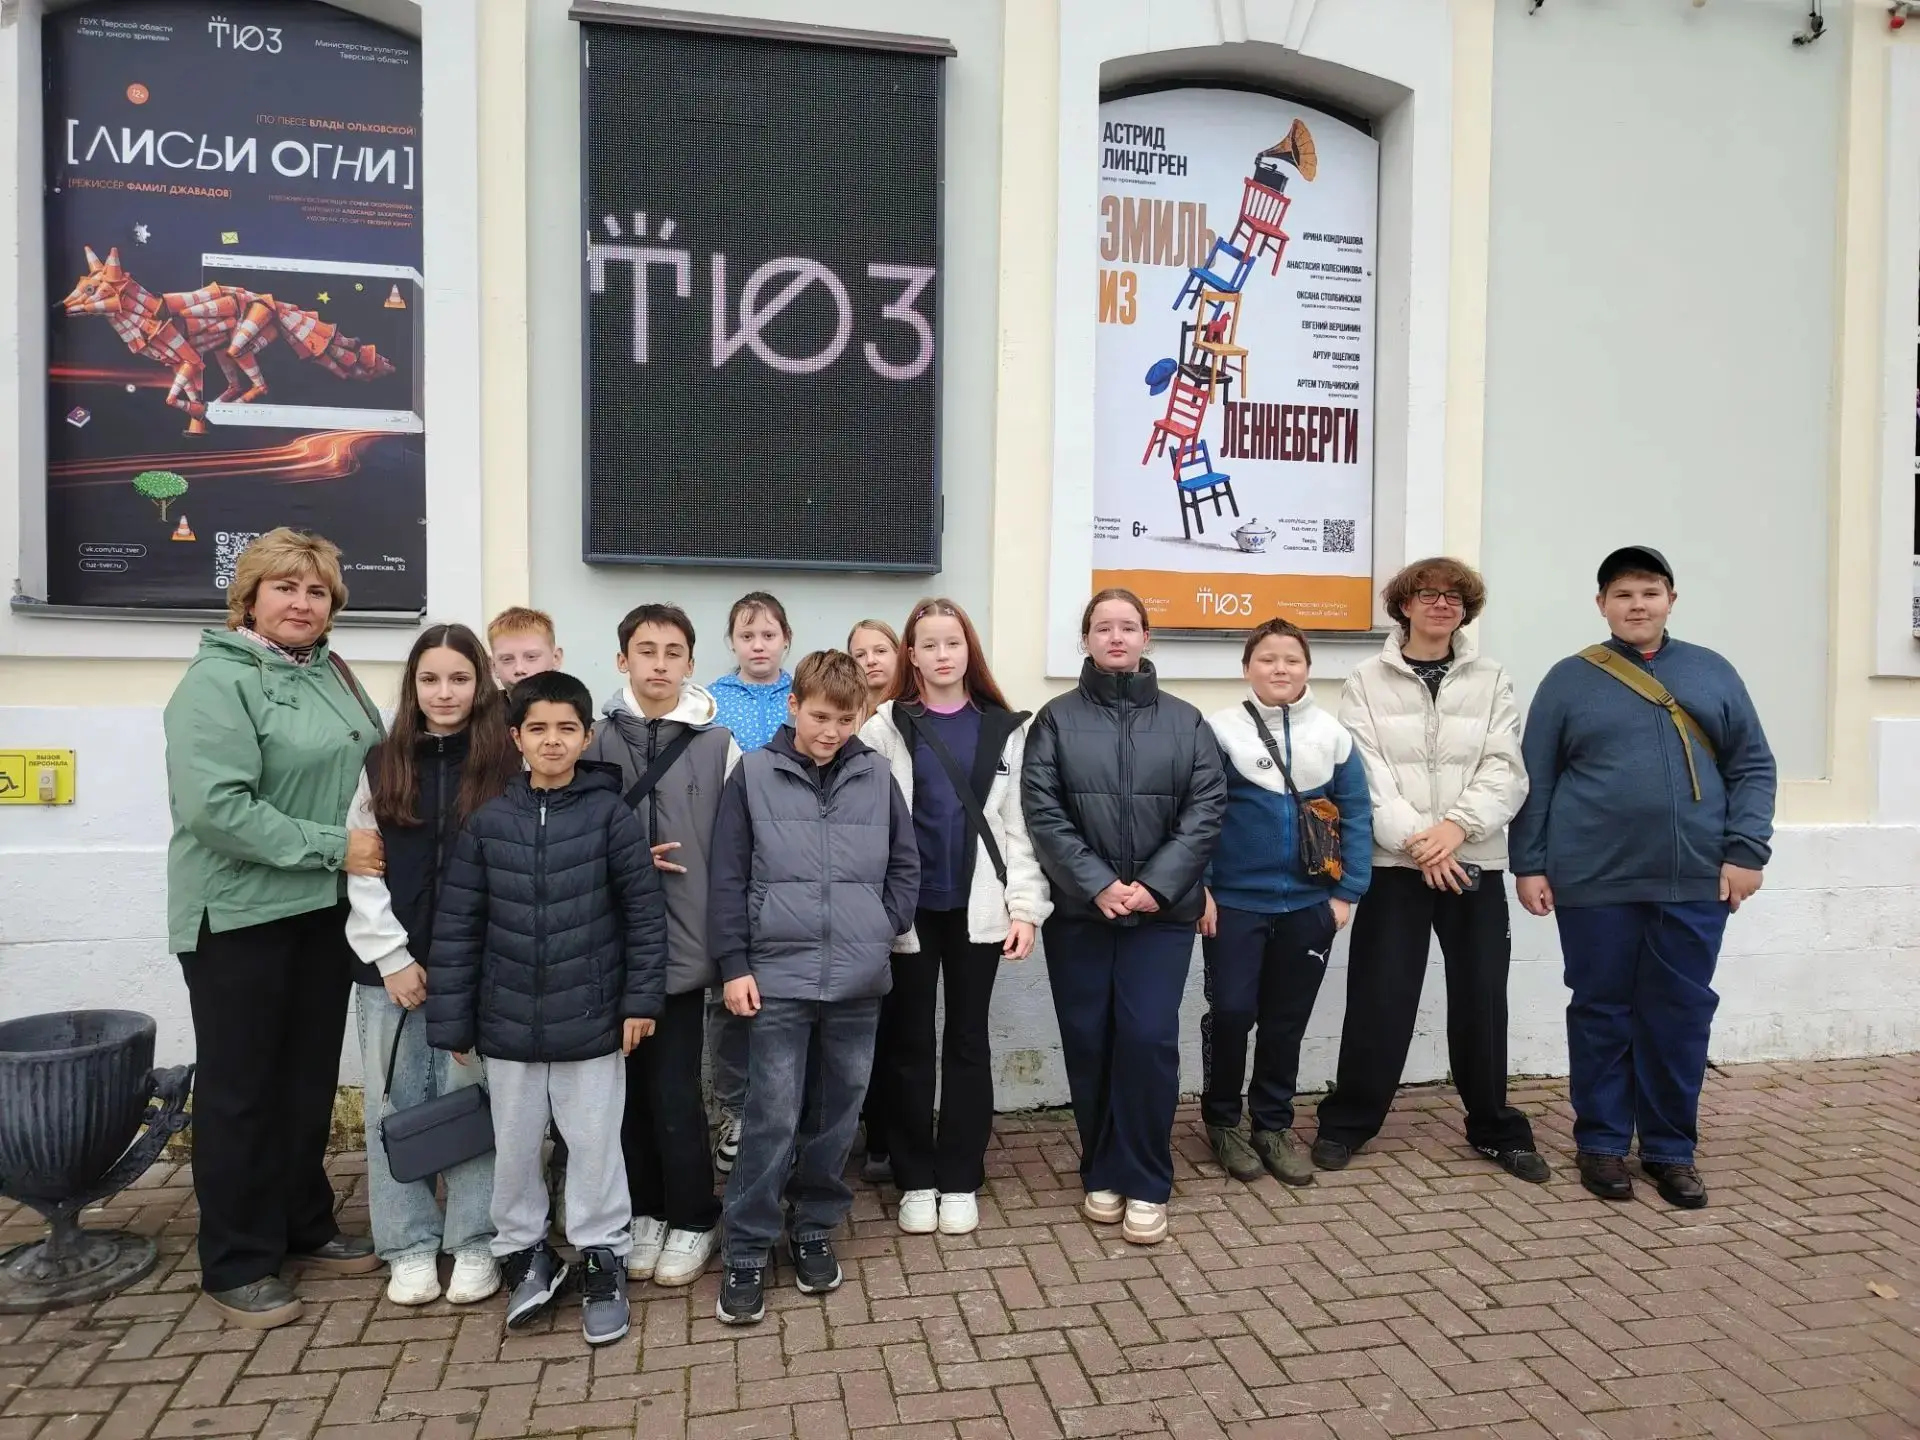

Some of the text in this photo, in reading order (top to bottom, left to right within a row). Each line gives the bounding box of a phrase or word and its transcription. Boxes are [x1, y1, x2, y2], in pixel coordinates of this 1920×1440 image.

[101, 19, 138, 30] Тверской
[140, 22, 174, 33] области
[106, 31, 132, 39] юного
[208, 16, 283, 54] ТЮЗ
[315, 40, 409, 56] Министерство культуры
[340, 51, 409, 65] Тверской области
[278, 115, 307, 127] ПЬЕСЕ
[309, 118, 345, 131] ВЛАДЫ
[1102, 121, 1166, 151] АСТРИД
[1102, 147, 1188, 177] ЛИНДГРЕН
[126, 181, 167, 194] ФАМИЛ
[1100, 195, 1217, 269] ЭМИЛЬ
[1303, 231, 1364, 246] ИРИНА КОНДРАШОВА
[1286, 260, 1363, 275] АНАСТАСИЯ КОЛЕСНИКОВА
[588, 212, 937, 380] ТЮЗ
[1098, 269, 1138, 325] ИЗ
[1296, 290, 1362, 304] ОКСАНА СТОЛБИНСКАЯ
[1301, 319, 1361, 333] ЕВГЕНИЙ ВЕРШИНИН
[1312, 350, 1361, 362] АРТУР ОЩЕПКОВ
[1317, 379, 1360, 391] ТУЛЬЧИНСКИЙ
[1220, 401, 1359, 464] ЛЕННЕБЕРГИ
[1132, 520, 1149, 538] 6+
[85, 545, 140, 555] vk.com/tuz_tver
[1196, 586, 1253, 616] ТЮЗ
